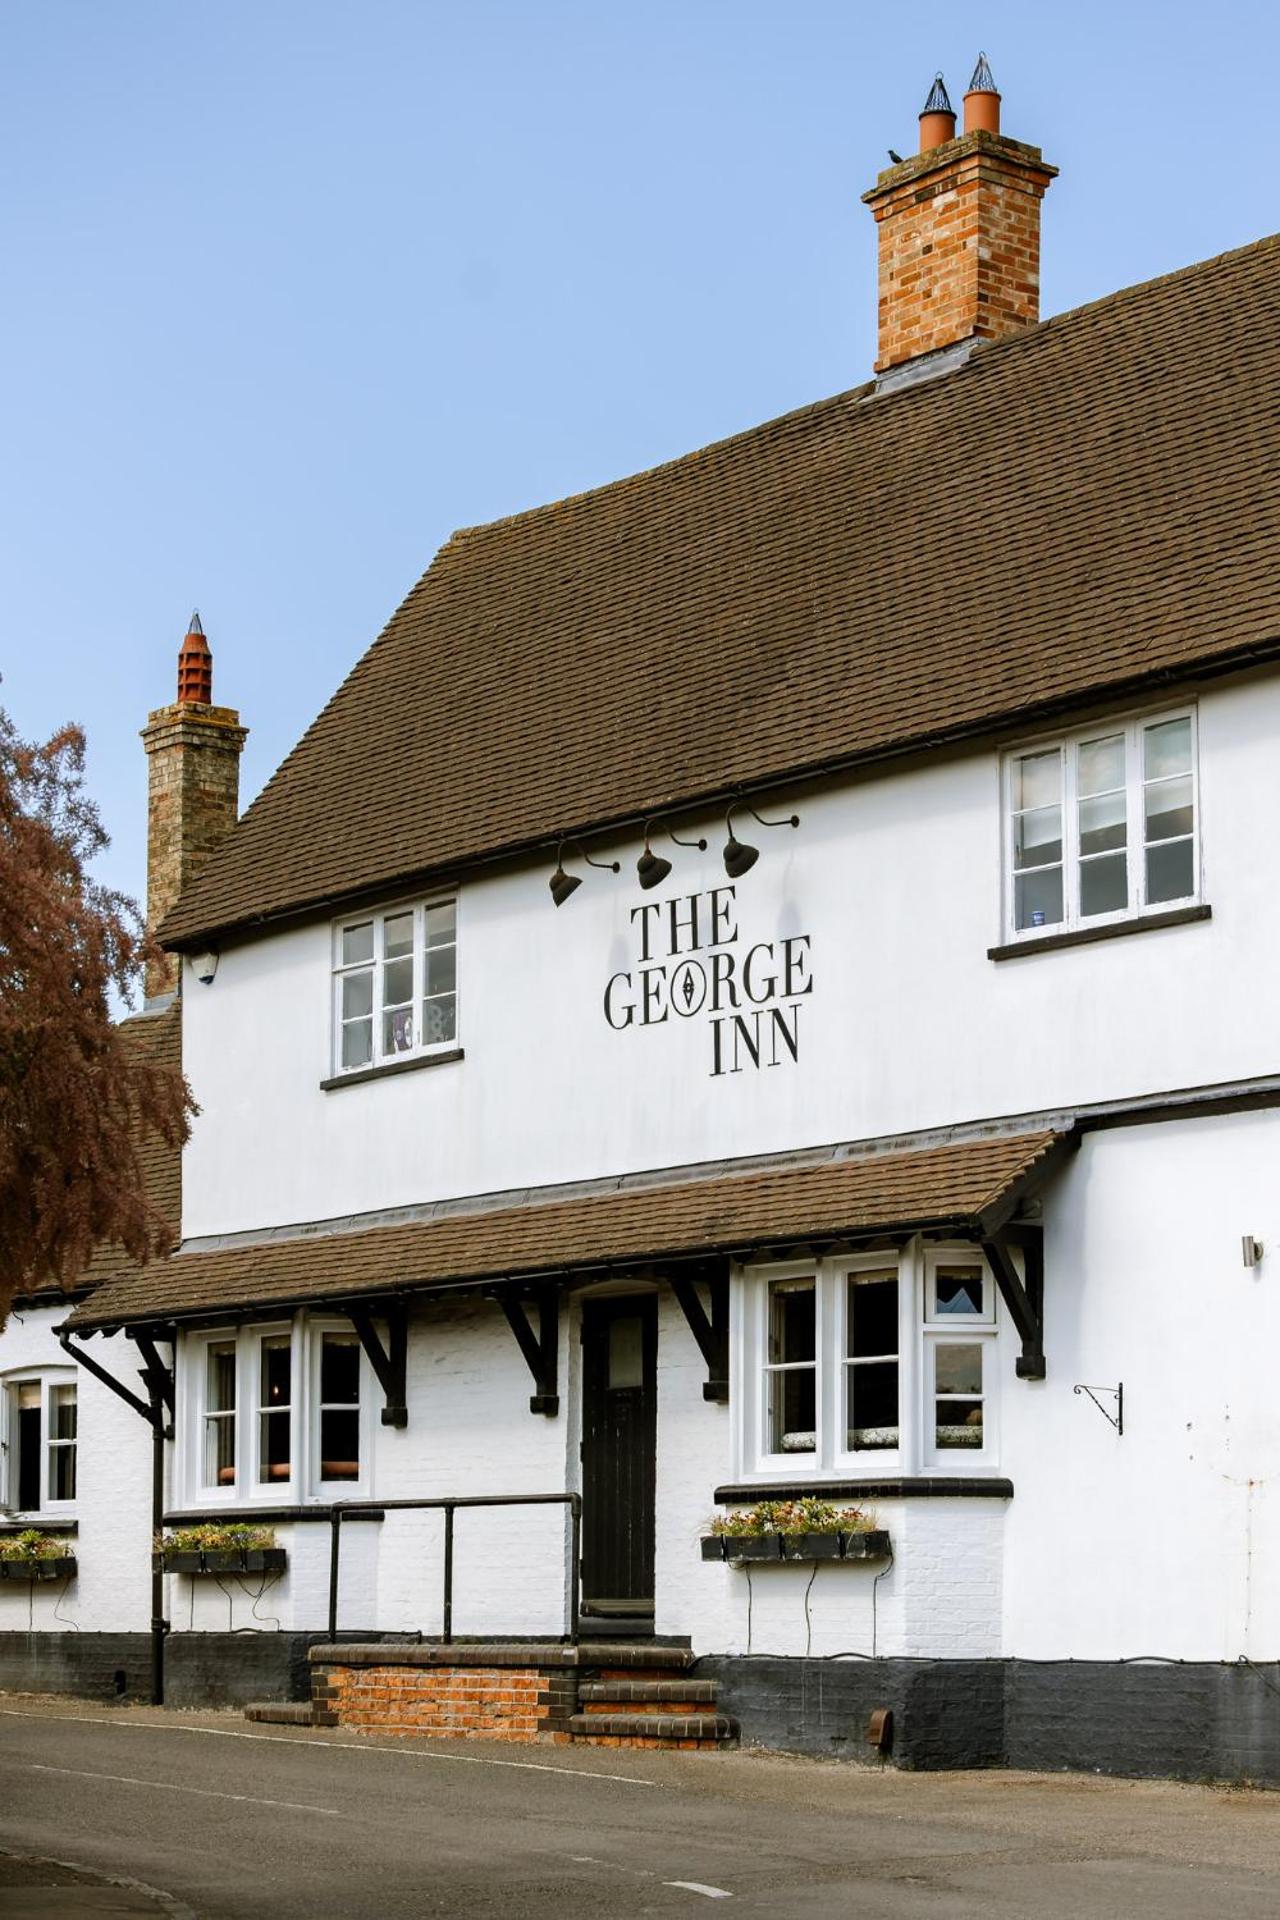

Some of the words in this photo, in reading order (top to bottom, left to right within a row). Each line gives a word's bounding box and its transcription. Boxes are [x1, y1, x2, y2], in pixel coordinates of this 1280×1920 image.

[630, 885, 738, 963] THE
[603, 934, 814, 1030] GEORGE
[708, 1003, 803, 1077] INN
